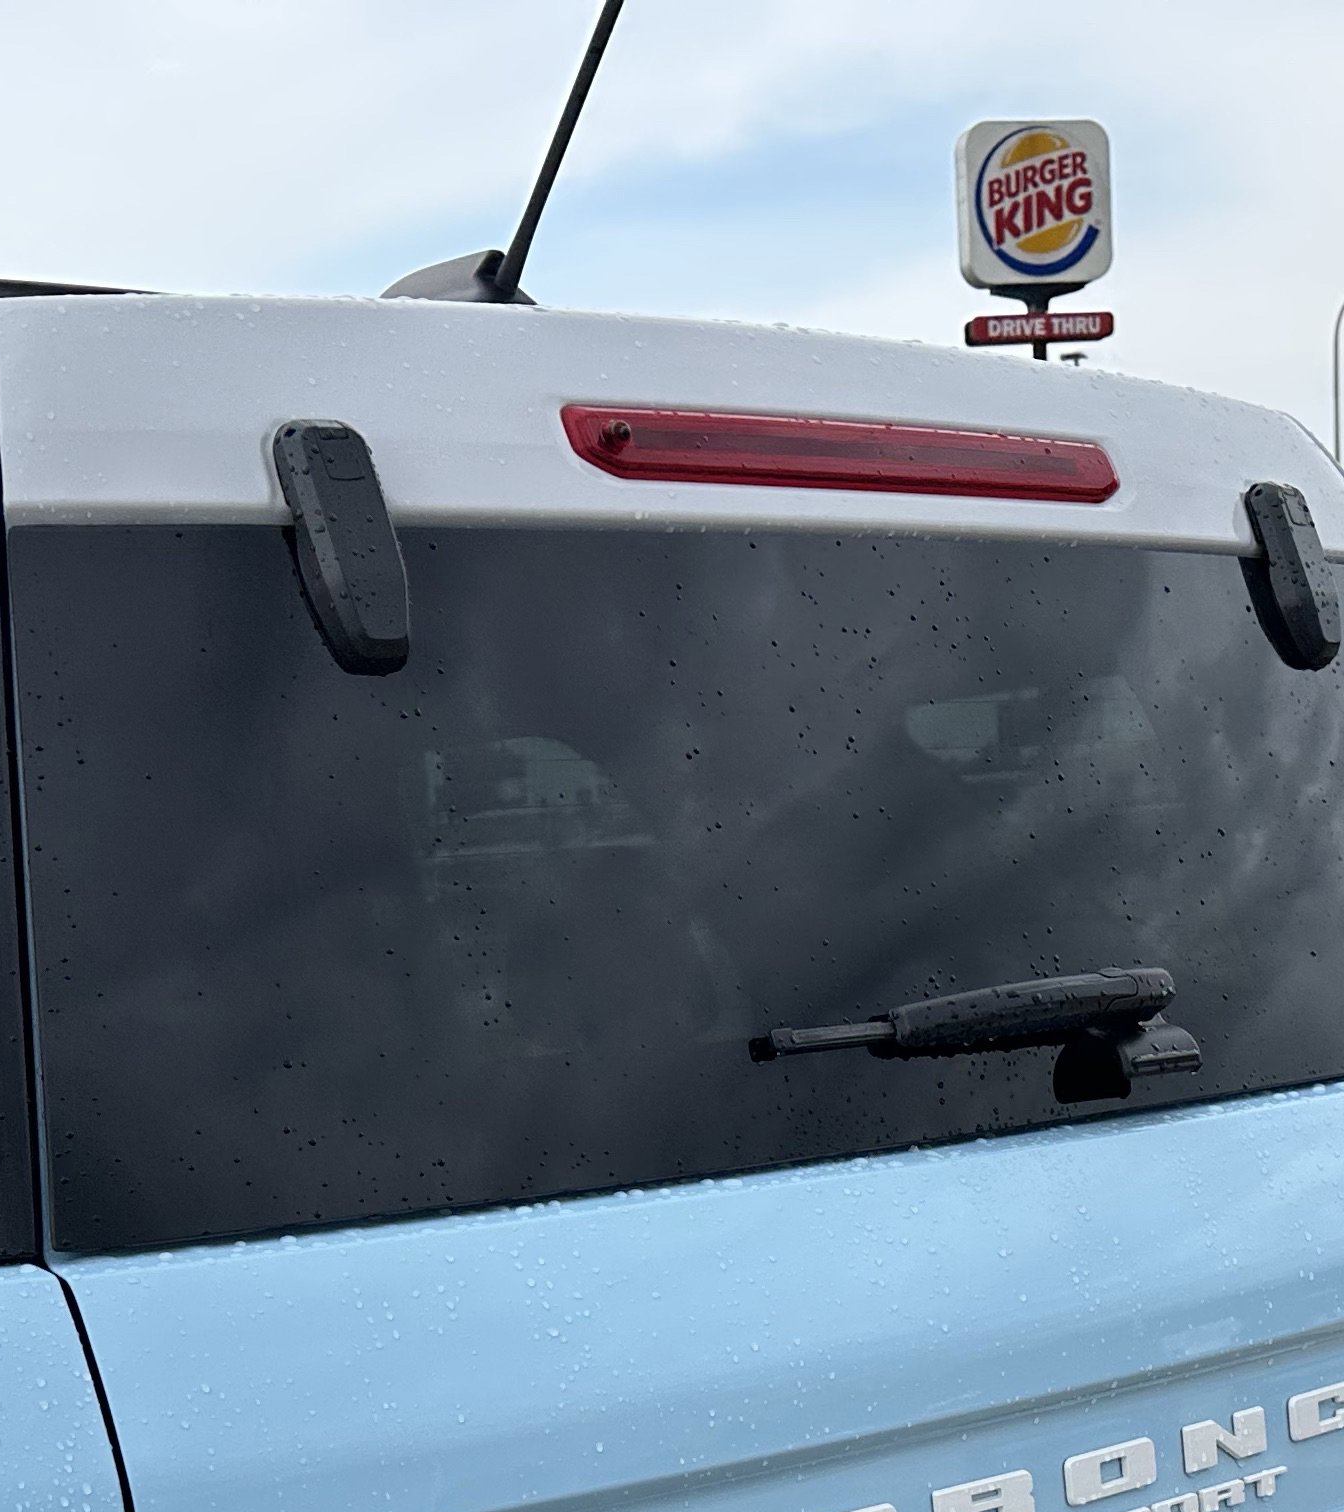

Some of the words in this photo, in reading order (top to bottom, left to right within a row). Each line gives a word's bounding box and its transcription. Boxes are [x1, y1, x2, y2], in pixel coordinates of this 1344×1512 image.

[988, 151, 1088, 208] BURGER
[993, 177, 1093, 246] KING
[988, 317, 1046, 337] DRIVE
[1051, 315, 1101, 334] THRU
